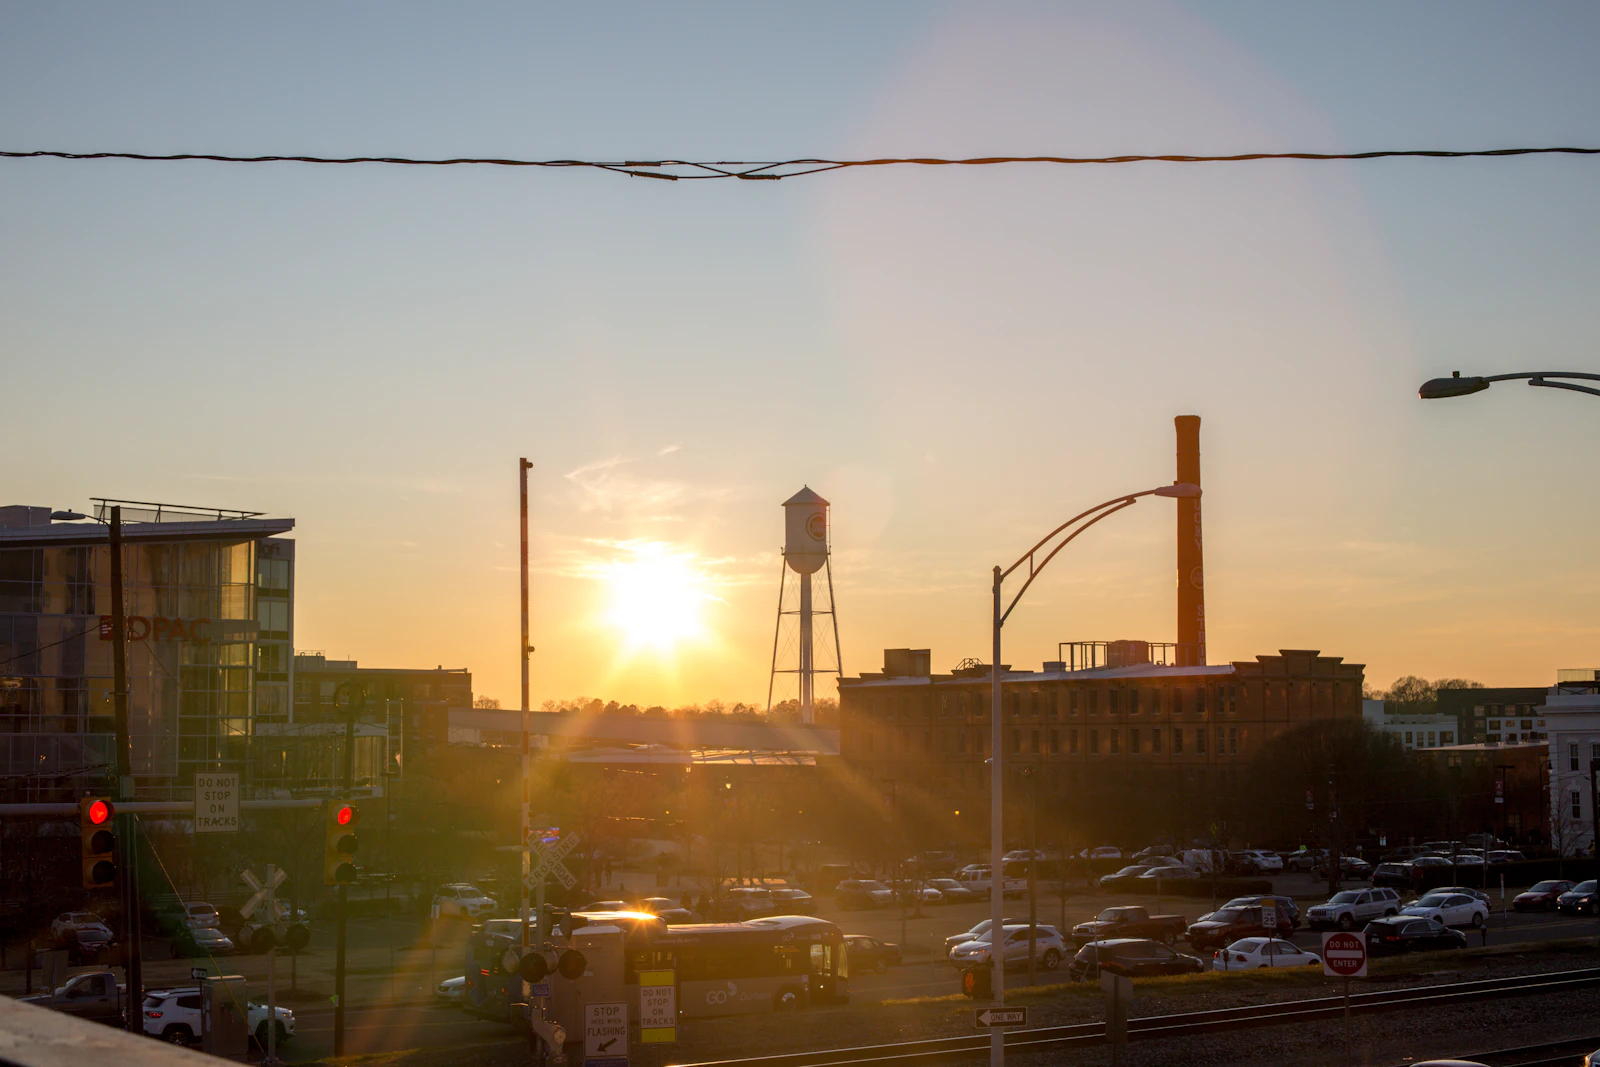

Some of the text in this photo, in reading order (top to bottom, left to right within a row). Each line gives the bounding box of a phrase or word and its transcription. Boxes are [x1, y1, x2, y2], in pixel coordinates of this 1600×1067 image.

[128, 616, 211, 643] DPAC
[199, 778, 236, 788] DO NOT
[204, 791, 231, 801] STOP
[210, 804, 225, 813] ON
[197, 816, 237, 827] TRACKS
[528, 836, 576, 886] CROSSING
[553, 863, 574, 888] ROAD
[1263, 916, 1275, 926] 25
[1329, 940, 1360, 949] DO NOT
[1333, 960, 1357, 968] ENTER
[642, 988, 672, 997] DO NOT
[706, 990, 727, 1005] GO
[647, 998, 669, 1007] STOP
[593, 1006, 620, 1017] STOP
[652, 1008, 664, 1016] ON
[642, 1017, 675, 1026] TRACKS
[990, 1012, 1022, 1022] ONE WAY
[587, 1026, 626, 1037] FLASHING
